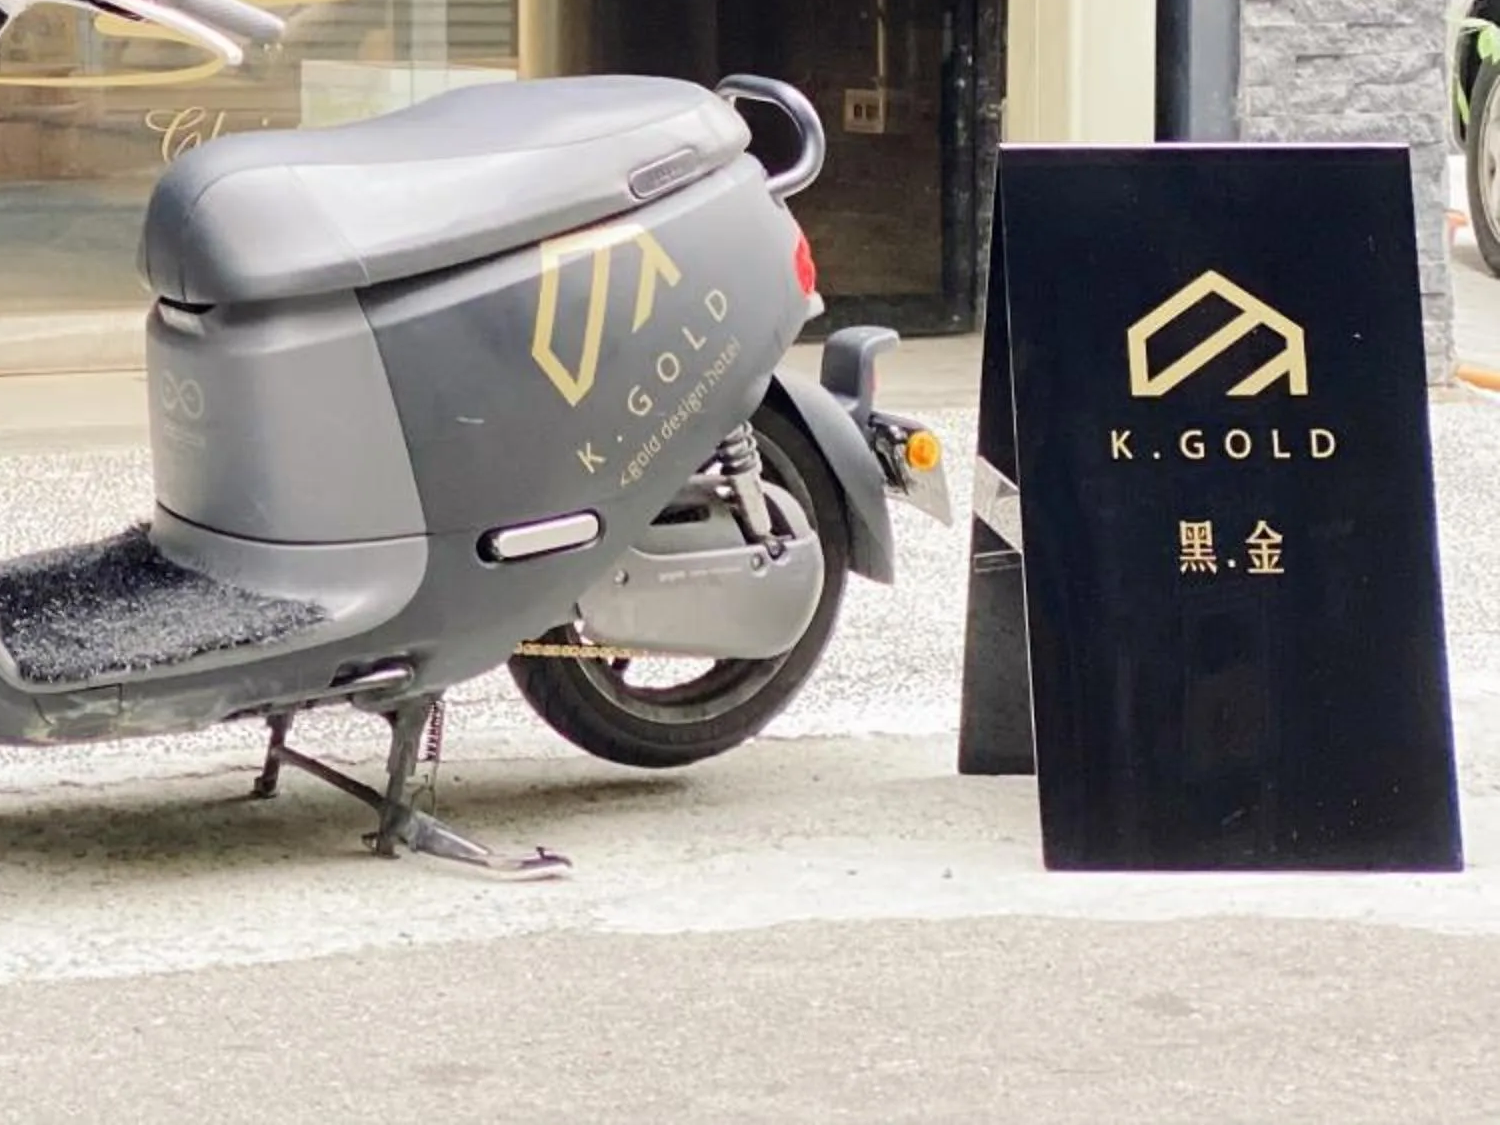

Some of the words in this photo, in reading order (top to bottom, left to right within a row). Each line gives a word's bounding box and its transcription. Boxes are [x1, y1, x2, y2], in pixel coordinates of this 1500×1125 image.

[577, 289, 728, 474] K.GOLD
[661, 381, 708, 440] design
[706, 334, 741, 387] hotel
[1110, 428, 1337, 460] K.GOLD
